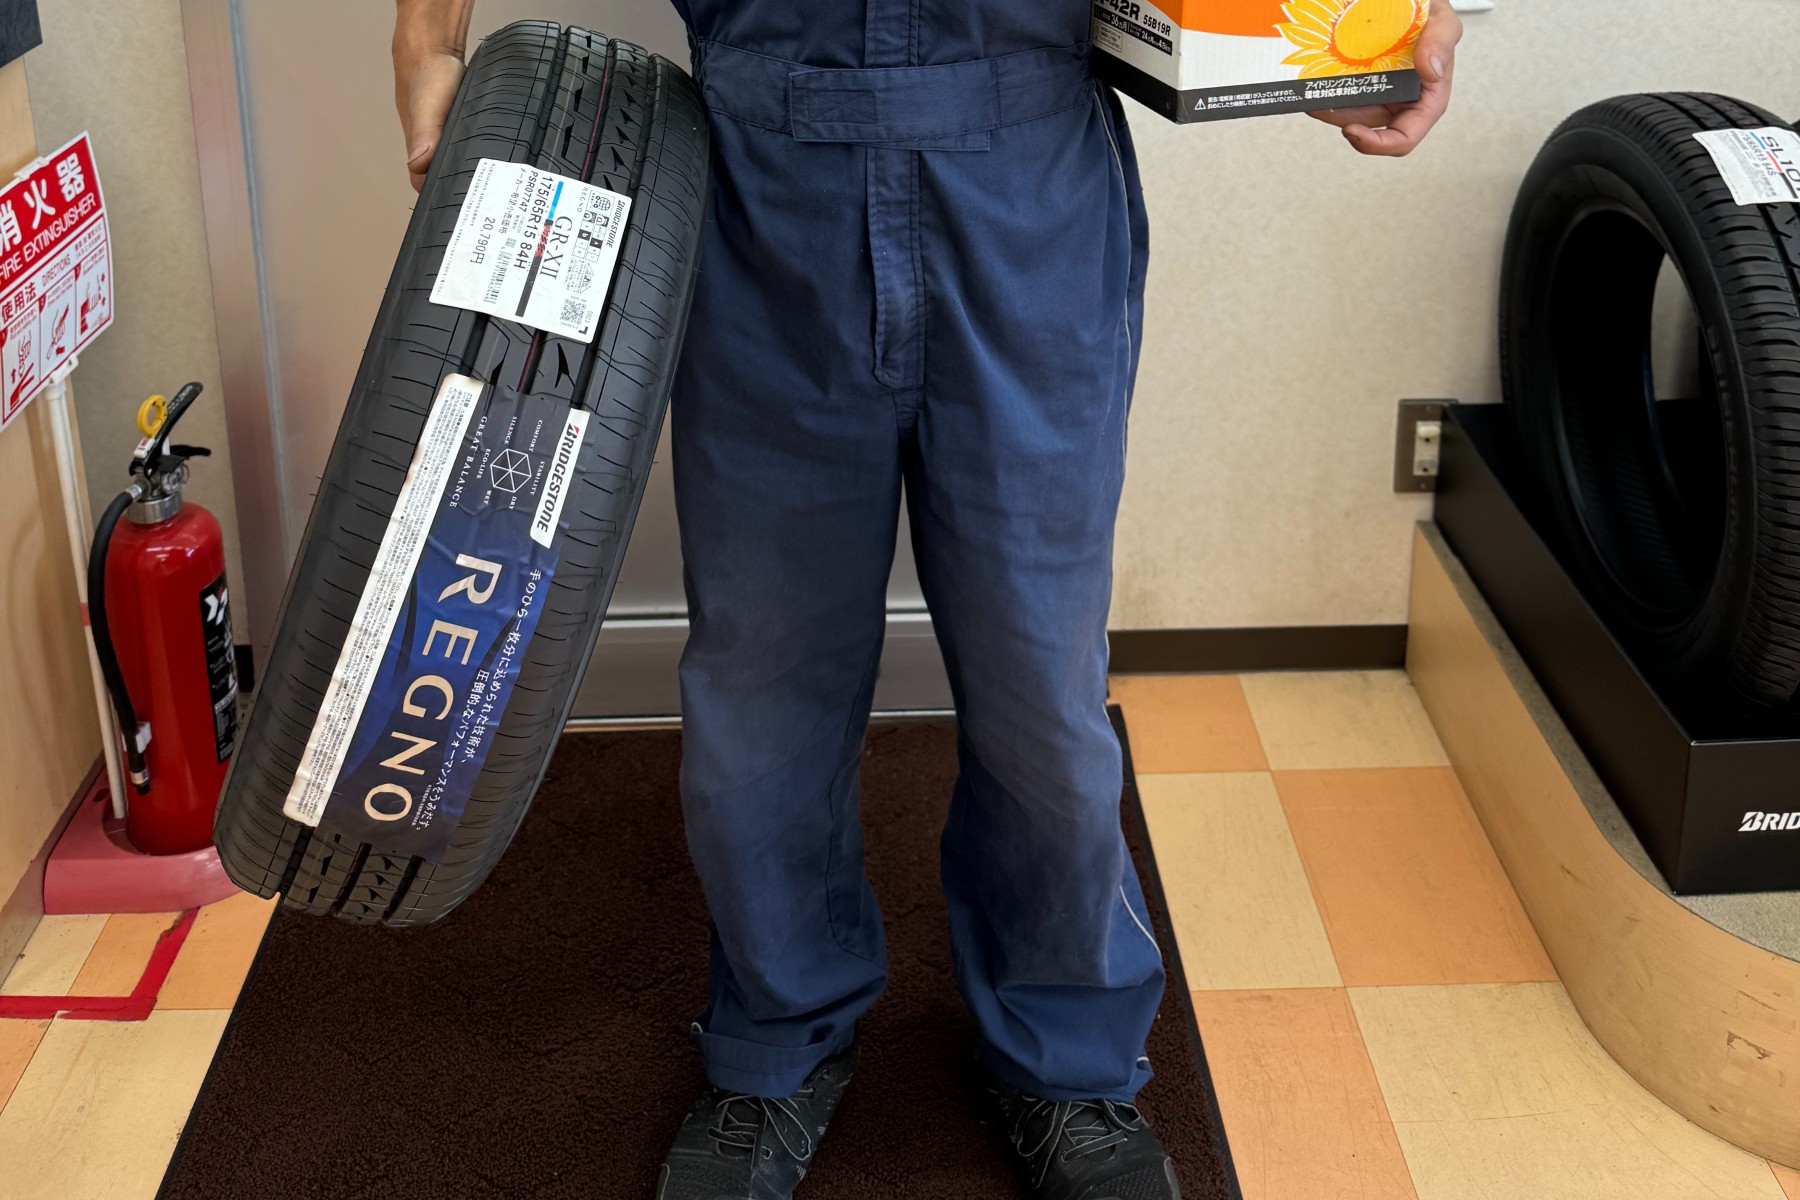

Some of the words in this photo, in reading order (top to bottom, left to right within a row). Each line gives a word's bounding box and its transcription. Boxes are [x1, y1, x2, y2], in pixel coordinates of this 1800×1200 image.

[1143, 14, 1171, 37] 55B19R
[0, 152, 85, 256] 消火器
[498, 167, 524, 234] メーカー希望小売価格
[518, 170, 538, 212] PSR07747
[523, 176, 554, 239] 175/65R15
[575, 186, 588, 213] REGNO
[23, 192, 96, 262] EXTINGUISHER
[604, 199, 625, 248] BRIDGESTONE
[513, 240, 533, 270] 84H
[2, 282, 37, 324] 使用法
[471, 415, 488, 452] GREAT
[504, 415, 518, 445] SILENCE
[529, 419, 543, 452] COMFORT
[449, 455, 474, 508] BALANCE
[483, 489, 492, 504] WET
[537, 423, 580, 534] BRIDGESTONE
[508, 496, 517, 510] DRY
[363, 552, 503, 821] REGNO
[1738, 811, 1800, 831] BRID
